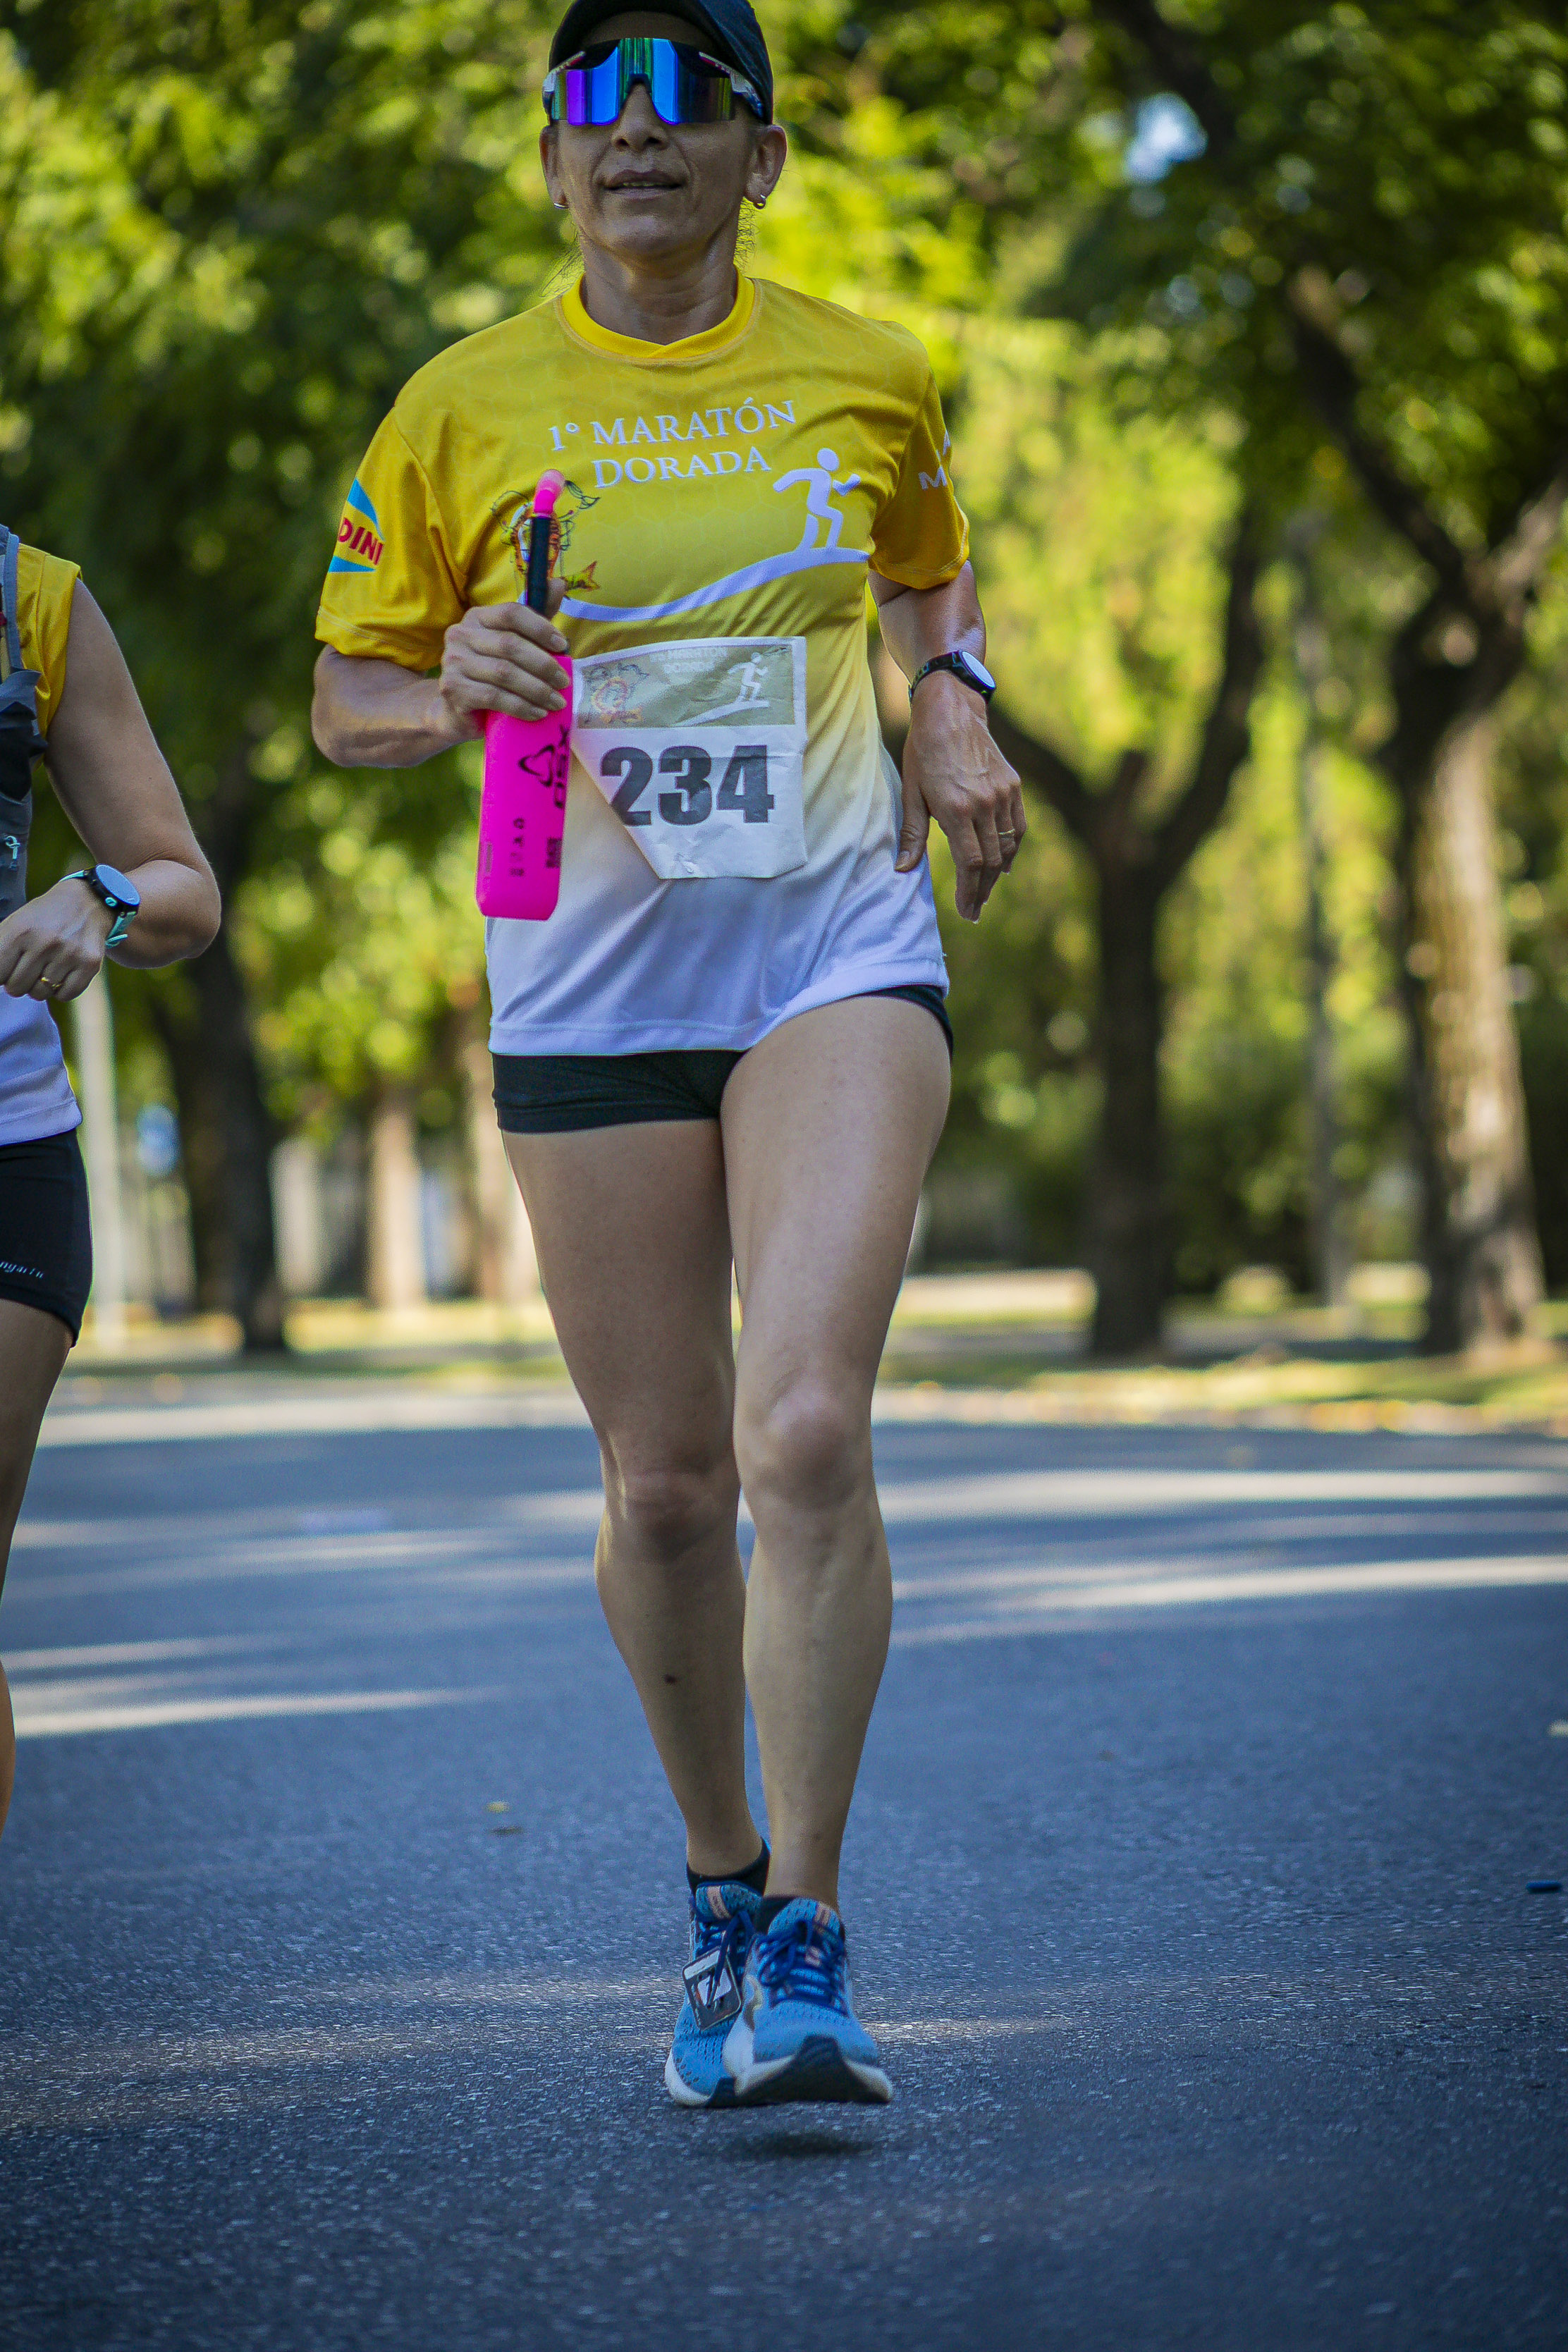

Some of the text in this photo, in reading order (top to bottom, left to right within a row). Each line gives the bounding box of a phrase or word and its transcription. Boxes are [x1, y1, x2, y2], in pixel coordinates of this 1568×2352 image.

[589, 396, 796, 446] MARATÓN
[590, 446, 772, 489] DORADA
[601, 744, 775, 827] 234
